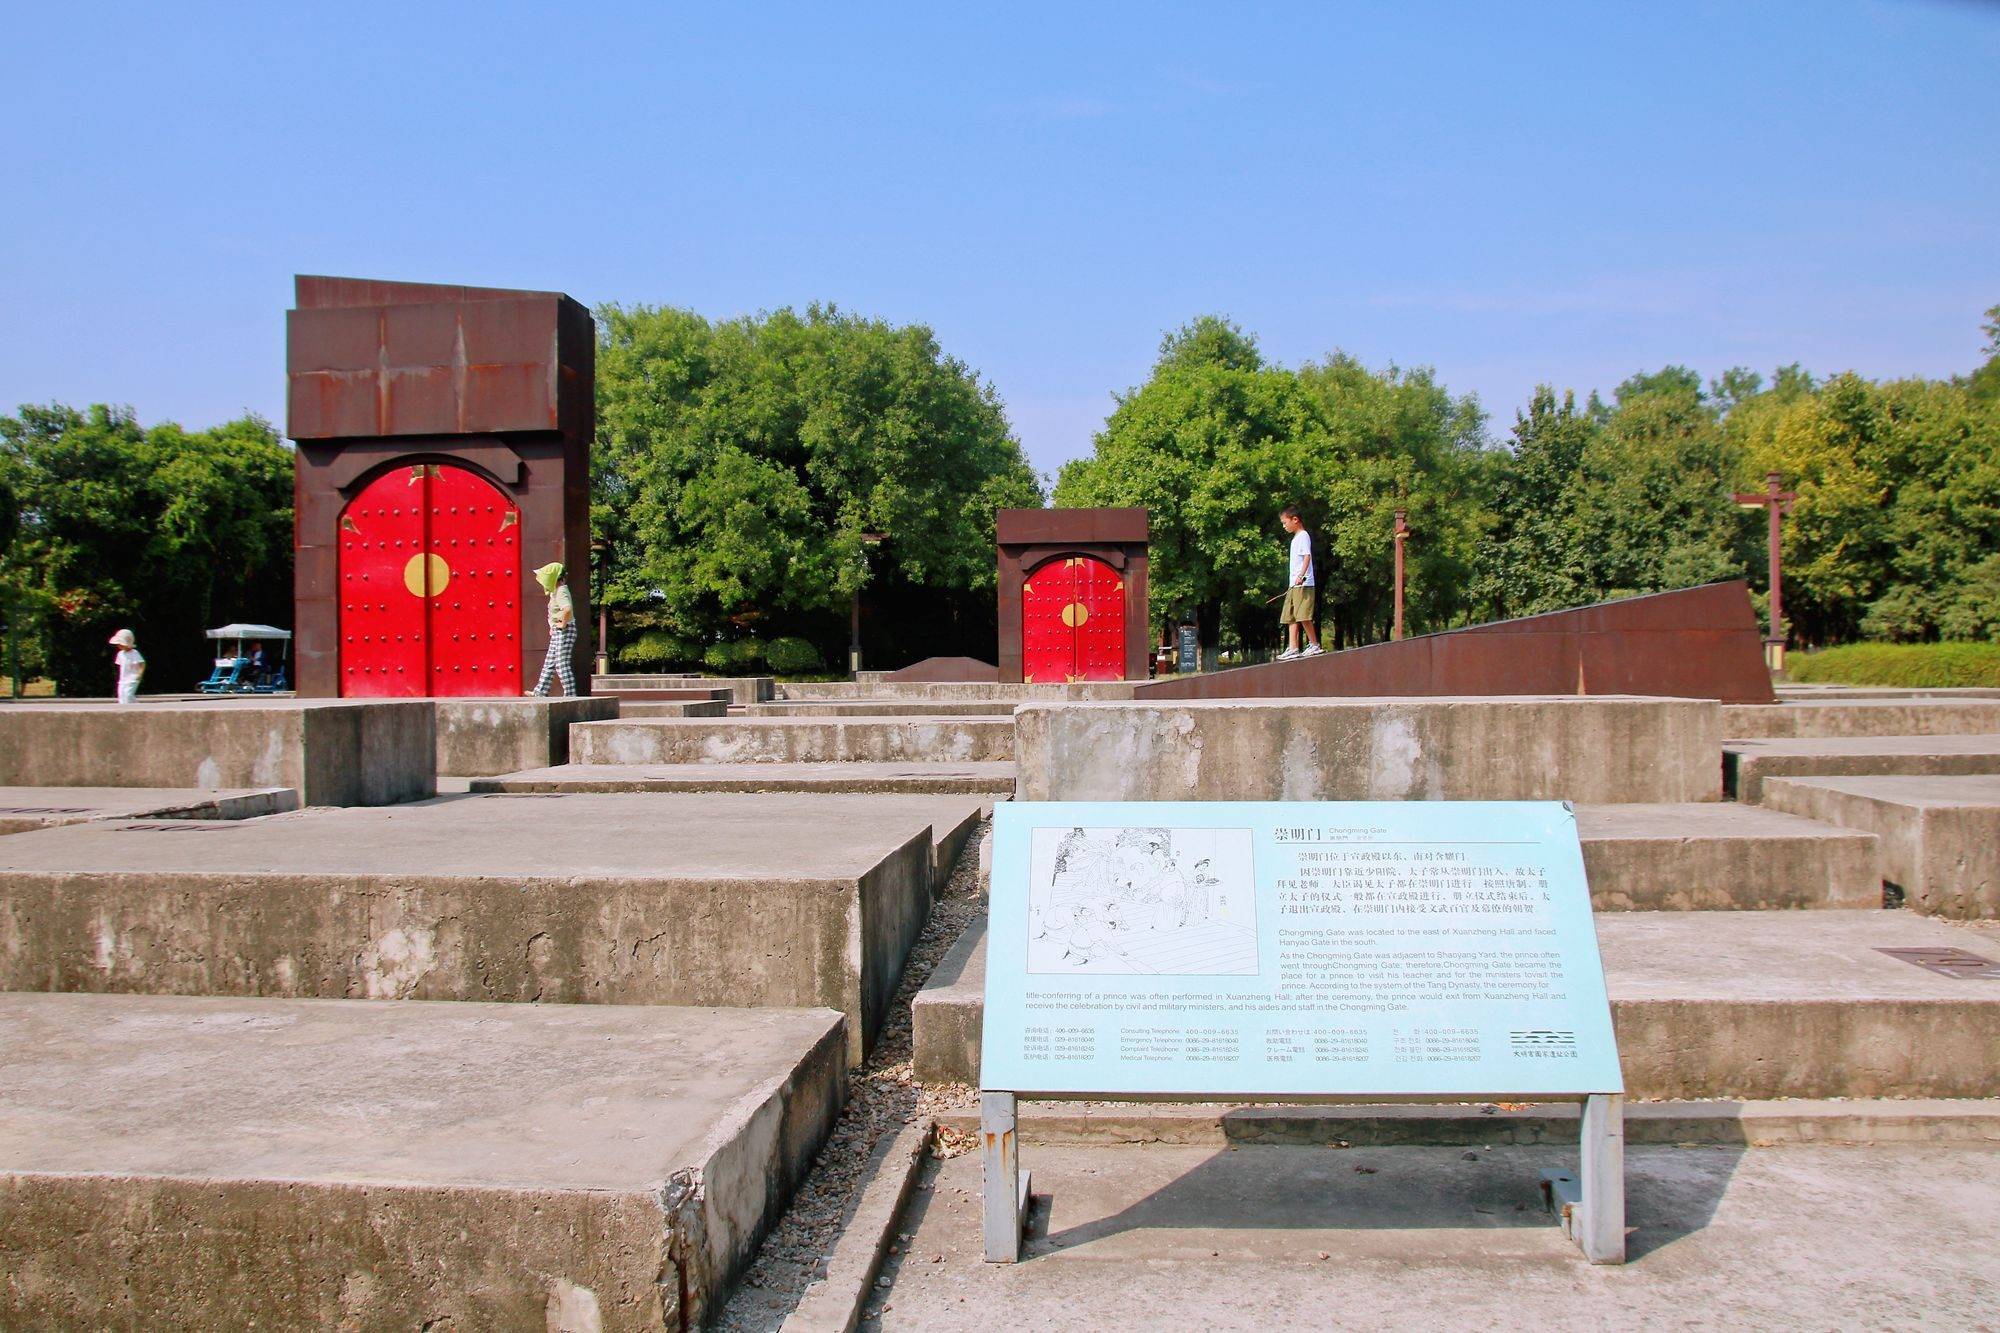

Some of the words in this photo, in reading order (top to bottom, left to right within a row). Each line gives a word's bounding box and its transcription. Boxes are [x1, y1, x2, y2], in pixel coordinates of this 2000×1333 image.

[1274, 828, 1321, 841] 崇明门
[1279, 929, 1324, 937] Chongming
[1452, 928, 1497, 937] Xuanzheng
[1279, 938, 1310, 947] Hanyao
[1307, 951, 1353, 960] Chongming
[1436, 951, 1477, 960] Shaoyang
[1515, 951, 1539, 959] prince
[1281, 972, 1303, 980] place
[1329, 972, 1354, 980] prince
[1310, 982, 1350, 990] According
[1374, 982, 1402, 990] system
[1426, 981, 1447, 990] Tang
[1026, 992, 1082, 1001] title-conferring
[1103, 993, 1128, 1001] prince
[1172, 993, 1213, 1002] performed
[1226, 994, 1271, 1002] Xuanzheng
[1392, 993, 1416, 1002] prince
[1484, 993, 1529, 1001] Xuanzheng
[1115, 1003, 1124, 1011] by
[1159, 1003, 1188, 1012] military
[1339, 1003, 1386, 1012] Chongming
